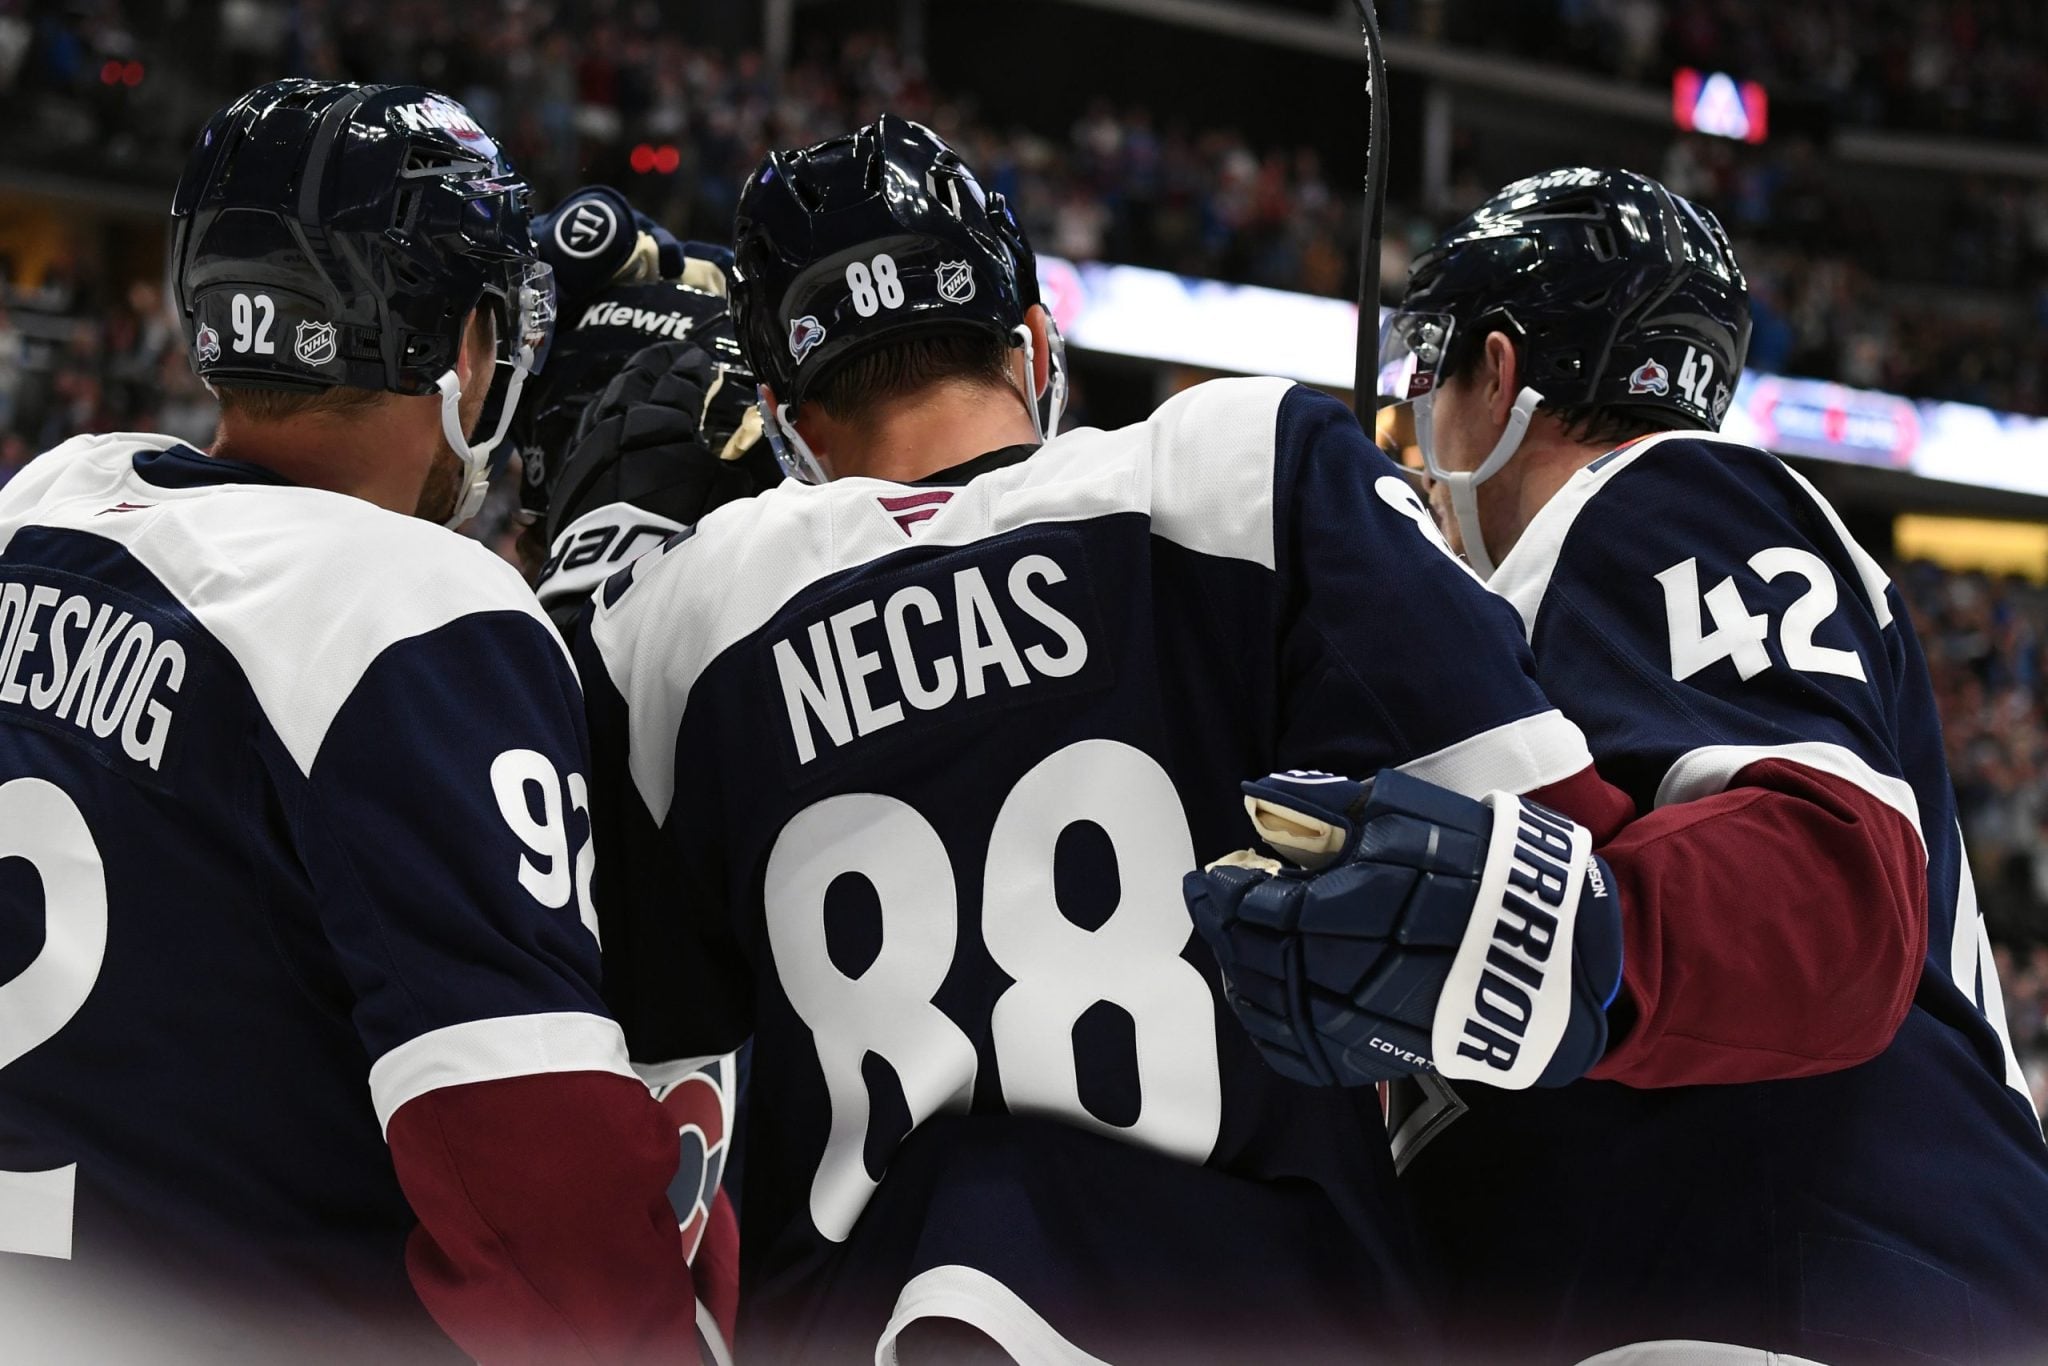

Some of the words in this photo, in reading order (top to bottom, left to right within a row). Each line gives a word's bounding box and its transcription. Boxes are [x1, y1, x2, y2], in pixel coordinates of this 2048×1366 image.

[845, 253, 905, 318] 88
[946, 271, 967, 295] NHL
[231, 293, 275, 354] 92
[303, 333, 329, 355] NHL
[576, 301, 694, 341] Kiewit
[1677, 345, 1714, 410] 42
[1653, 546, 1868, 684] 42
[0, 582, 187, 772] DESKOG
[772, 554, 1089, 765] NECAS
[764, 738, 1223, 1243] 88
